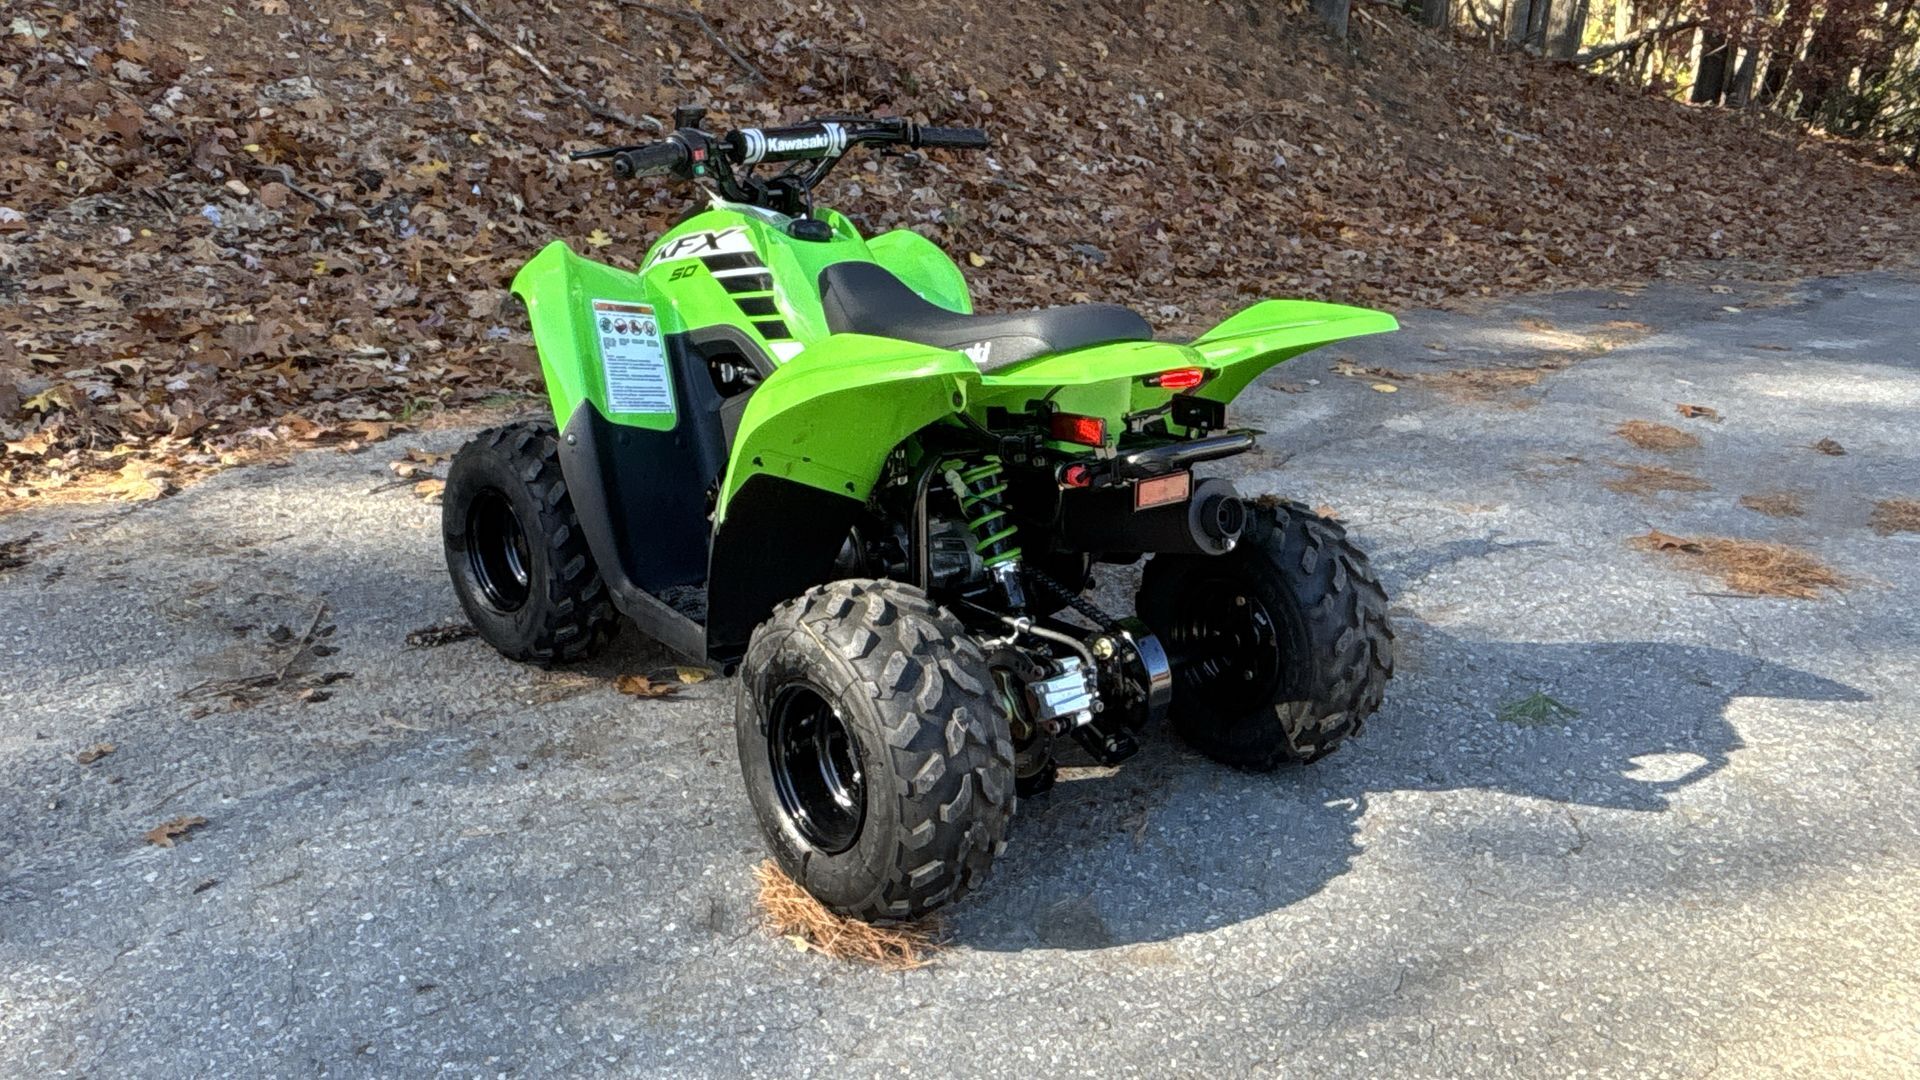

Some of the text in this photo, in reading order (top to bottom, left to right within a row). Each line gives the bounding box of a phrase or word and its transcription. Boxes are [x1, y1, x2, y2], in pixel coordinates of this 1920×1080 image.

[767, 133, 828, 152] Kawasaki
[647, 229, 739, 268] KFX
[668, 264, 699, 282] 50
